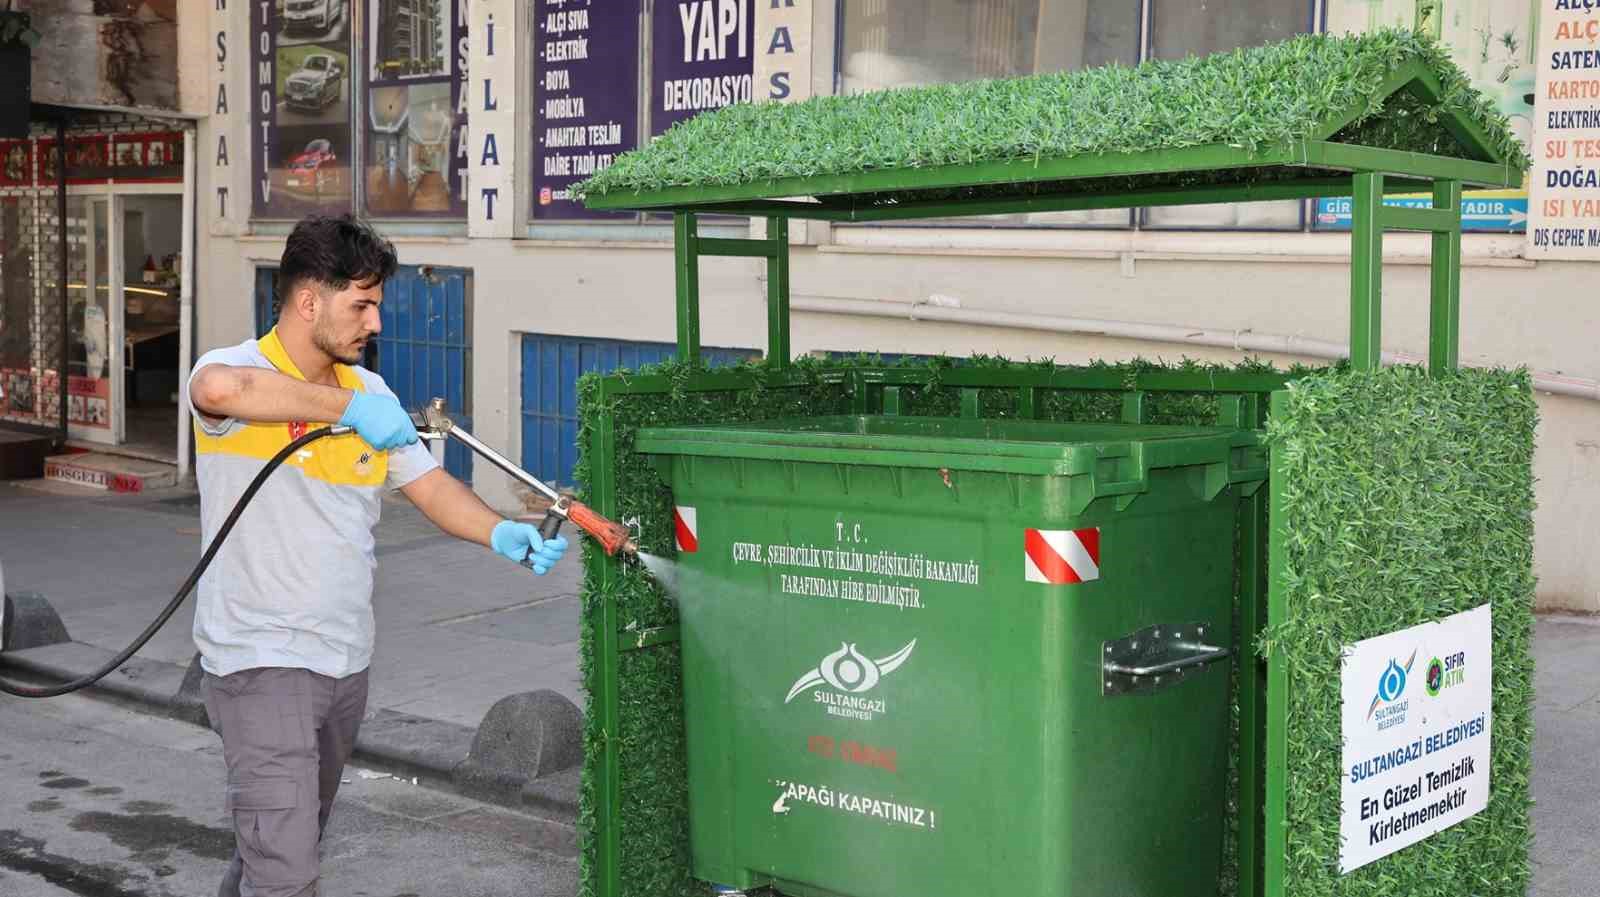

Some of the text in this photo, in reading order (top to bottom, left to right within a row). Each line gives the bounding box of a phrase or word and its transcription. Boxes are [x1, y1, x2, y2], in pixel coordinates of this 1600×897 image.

[546, 9, 589, 37] ALÇI SIVA
[679, 0, 747, 62] YAPI
[546, 35, 588, 61] ELEKTRİK
[546, 70, 570, 90] BOYA
[546, 94, 584, 119] MOBİLYA
[545, 121, 621, 147] ANAHTAR TESLİM
[1545, 140, 1567, 158] SU
[544, 152, 570, 176] DAİRE
[1546, 165, 1600, 187] DOĞA
[1327, 200, 1351, 213] GİR
[1543, 199, 1565, 217] ISI
[1534, 228, 1549, 251] DIŞ
[1552, 228, 1584, 247] CEPHE
[768, 541, 820, 567] ŞEHİRCİLİK
[822, 550, 834, 569] VE
[836, 545, 863, 572] İKLİM
[865, 550, 924, 579] DEĞİŞİKLİĞİ
[926, 559, 979, 585] BAKANLIĞI
[781, 574, 839, 598] TARAFINDAN
[840, 576, 864, 601] HİBE
[1445, 651, 1465, 672] SIFIR
[1445, 668, 1465, 689] ATIK
[814, 690, 886, 713] SULTANGAZİ
[827, 705, 872, 721] BELEDİYESİ
[1351, 712, 1485, 784] SULTANGAZİ BELEDİYESİ
[1360, 756, 1475, 821] En Güzel Temizlik
[839, 792, 925, 826] KAPATINIZ
[1369, 788, 1467, 846] Kirletmemektir
